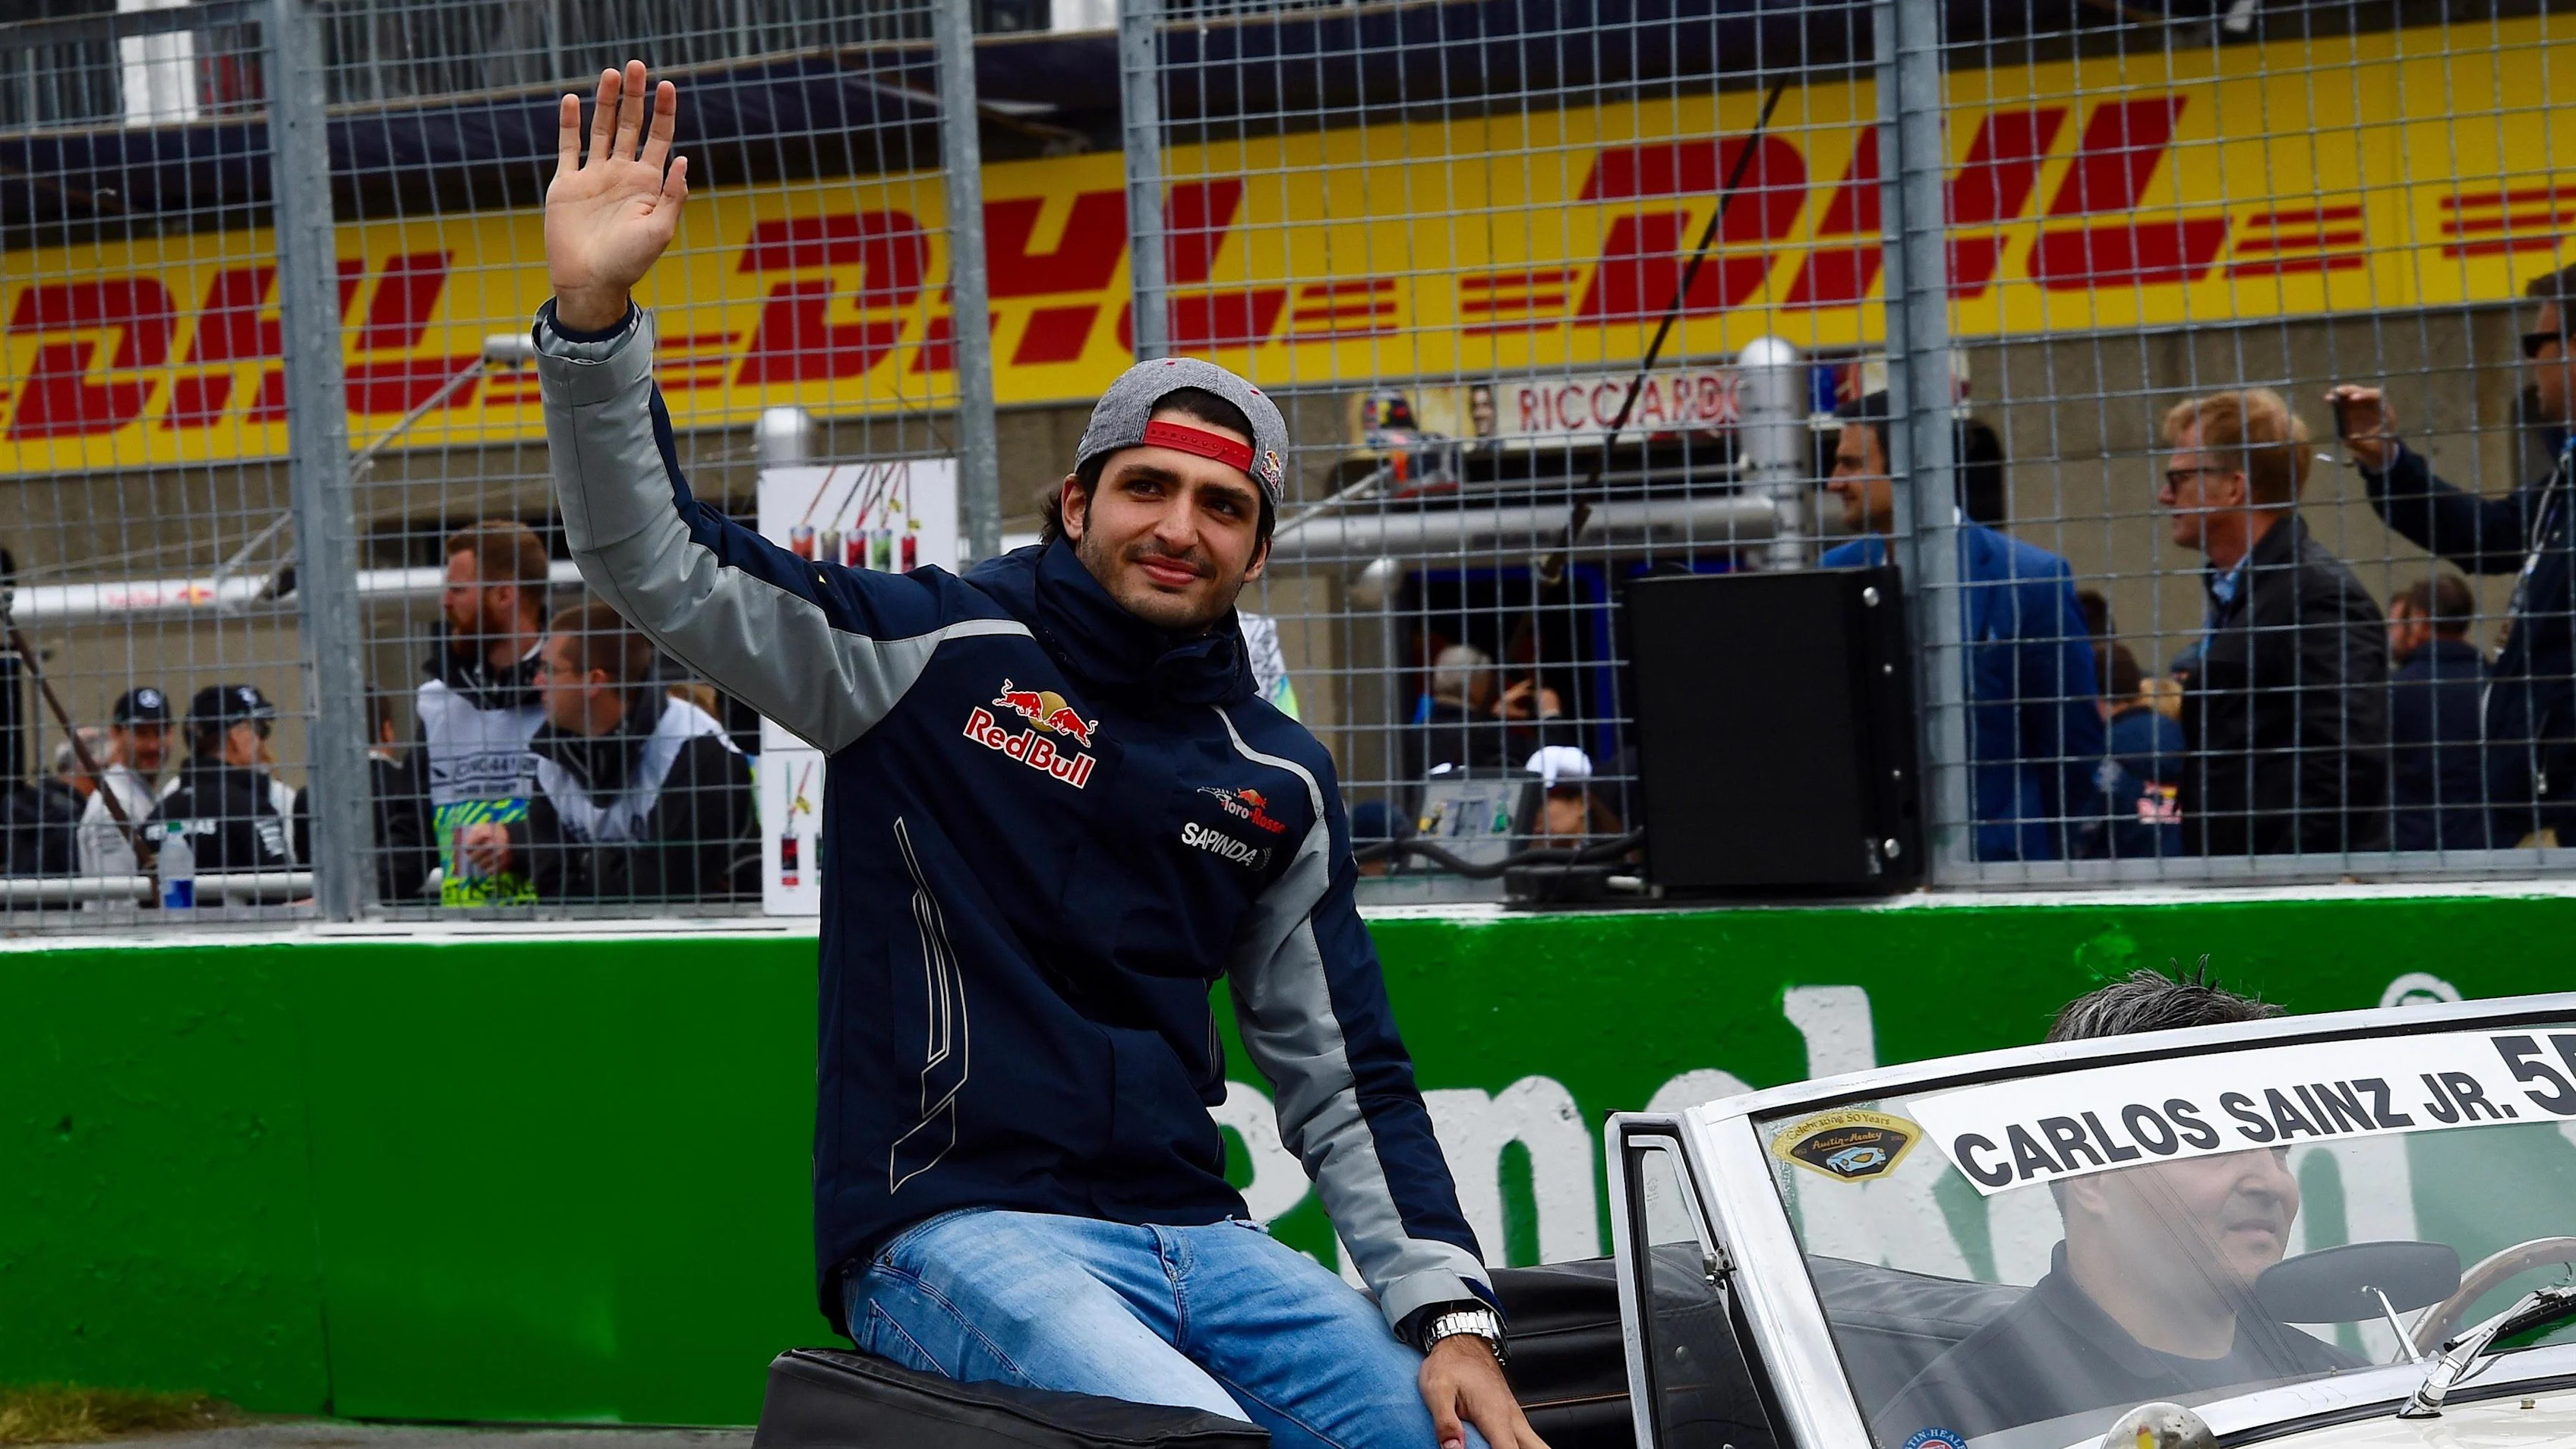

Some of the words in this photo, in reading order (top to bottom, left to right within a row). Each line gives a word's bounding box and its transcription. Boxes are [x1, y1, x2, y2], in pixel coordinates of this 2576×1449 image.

[1573, 95, 2233, 328] DHL
[734, 178, 1289, 386] DHL
[5, 250, 481, 441] DHL
[963, 706, 1036, 762] Red
[1025, 735, 1096, 789] Bull
[1182, 822, 1258, 867] SAPINDA
[1812, 1132, 1883, 1151] Austin-Healey
[1846, 1113, 1861, 1122] 50
[1862, 1114, 1890, 1125] Years
[1954, 1098, 2221, 1187] CARLOS
[2219, 1078, 2416, 1142] SAINZ
[2420, 1072, 2520, 1124] JR.
